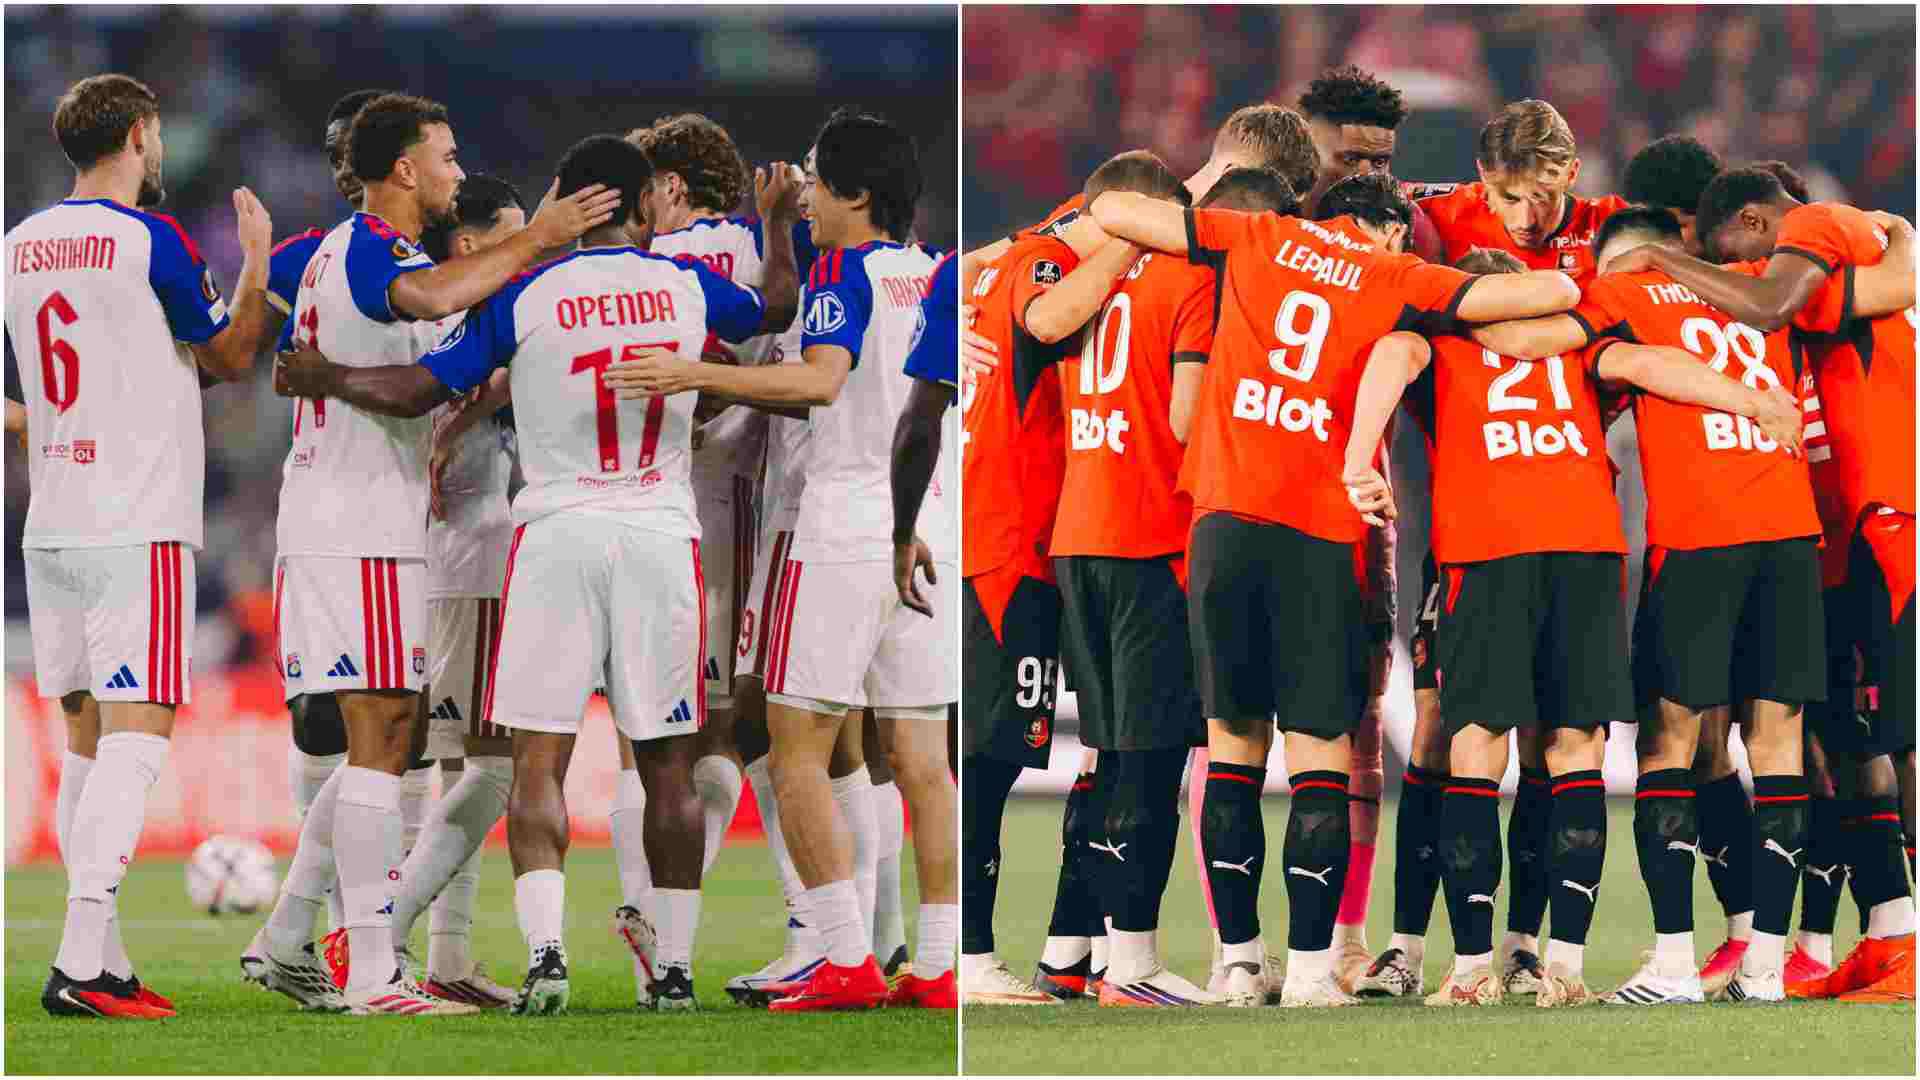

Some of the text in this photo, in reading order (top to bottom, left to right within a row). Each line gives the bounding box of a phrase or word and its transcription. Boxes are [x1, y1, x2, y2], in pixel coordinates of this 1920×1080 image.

[12, 235, 116, 275] TESSMANN
[1275, 239, 1362, 293] LEPAUL
[557, 289, 676, 331] OPENDA
[1268, 289, 1331, 383] 9
[36, 290, 79, 415] 6
[1080, 292, 1132, 395] 10
[569, 341, 680, 472] 17
[1233, 378, 1333, 442] Blot
[1482, 347, 1574, 413] 21
[1482, 419, 1589, 462] Blot
